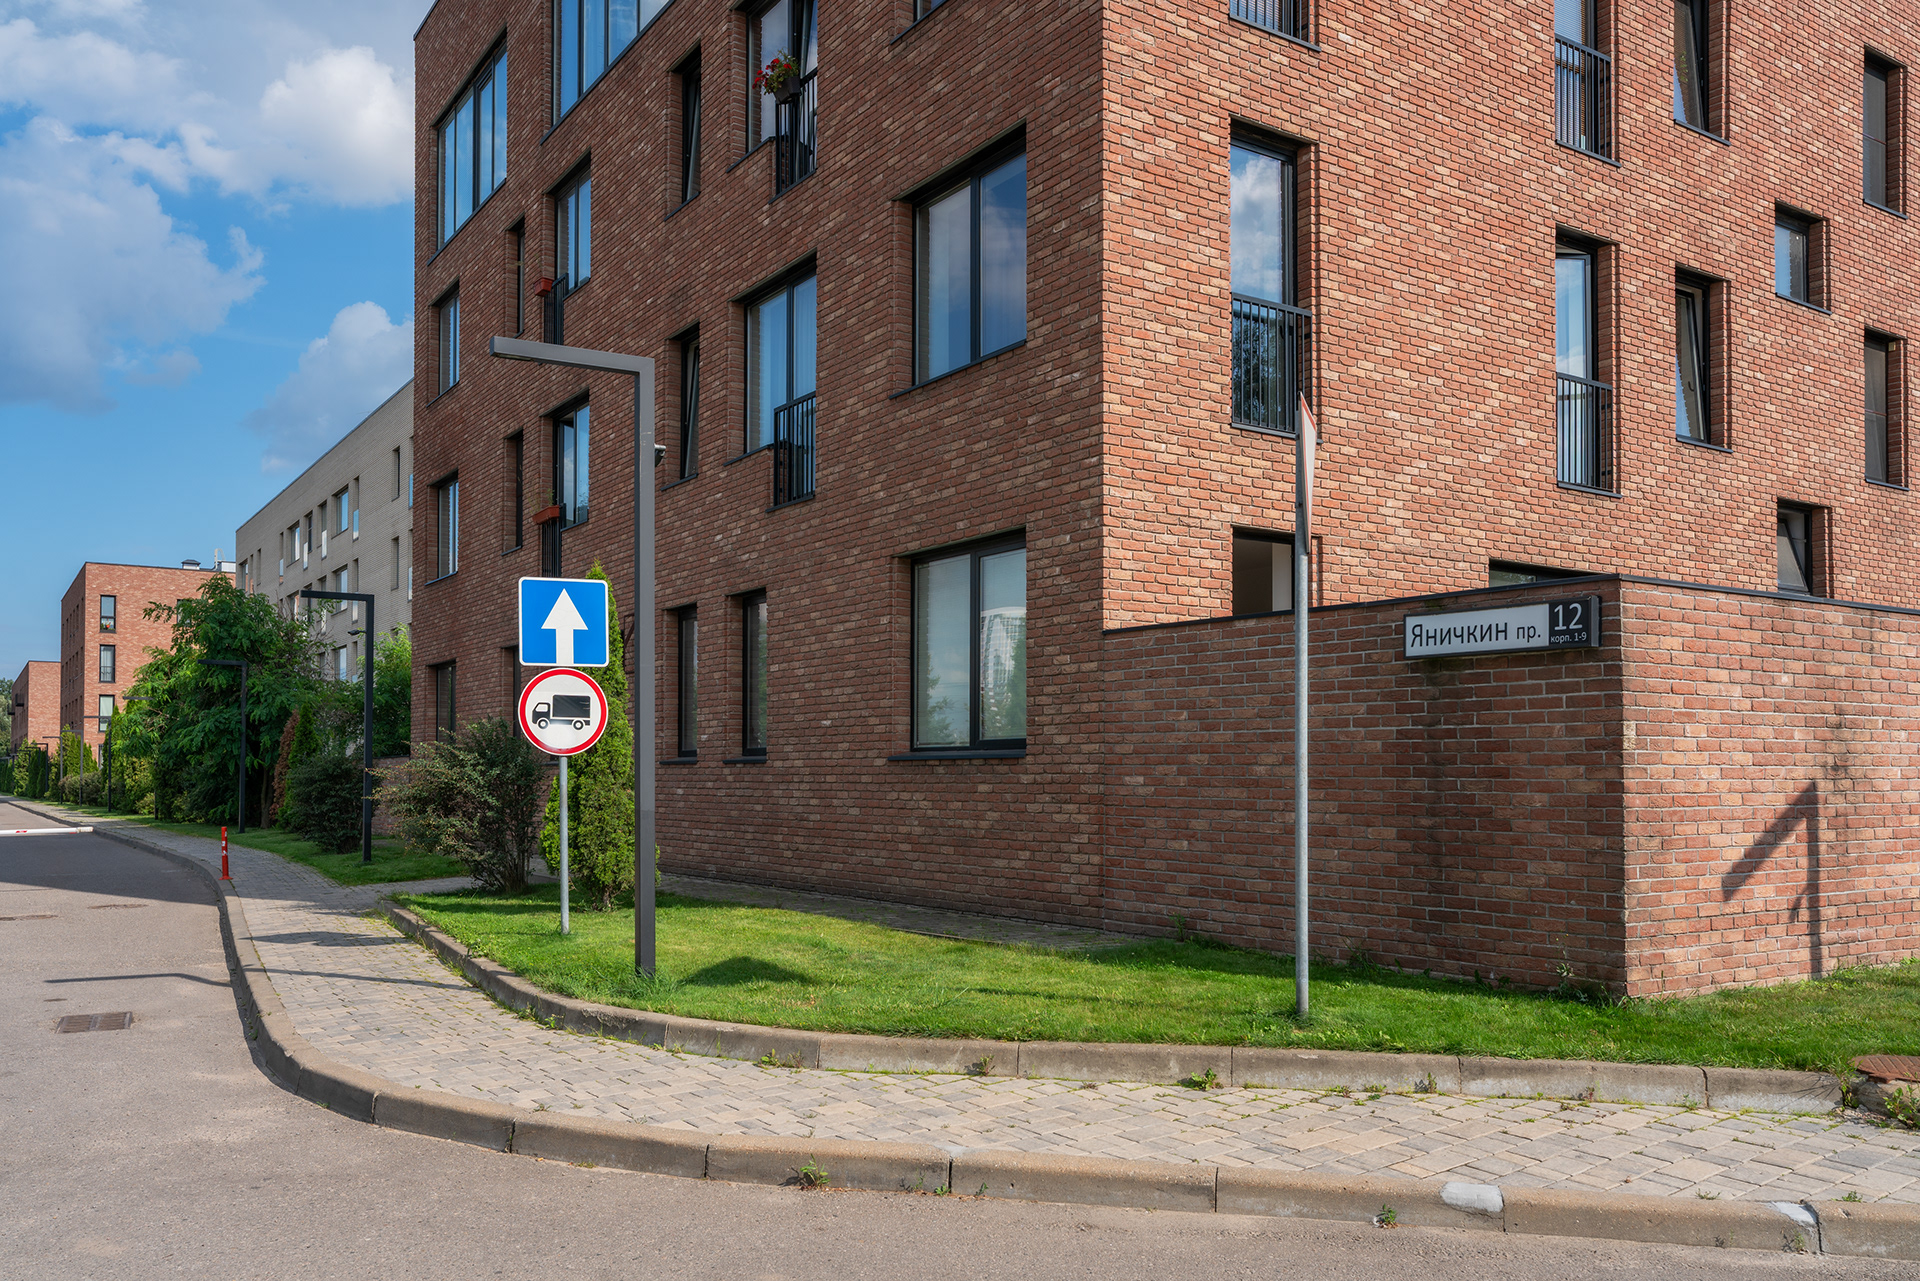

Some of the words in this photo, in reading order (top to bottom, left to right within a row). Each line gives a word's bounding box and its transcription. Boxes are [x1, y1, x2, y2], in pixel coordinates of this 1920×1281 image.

[1554, 602, 1583, 631] 12
[1410, 622, 1508, 648] Яничкин
[1516, 625, 1541, 643] пр.
[1550, 634, 1573, 644] корп.
[1574, 632, 1587, 641] 1-9
